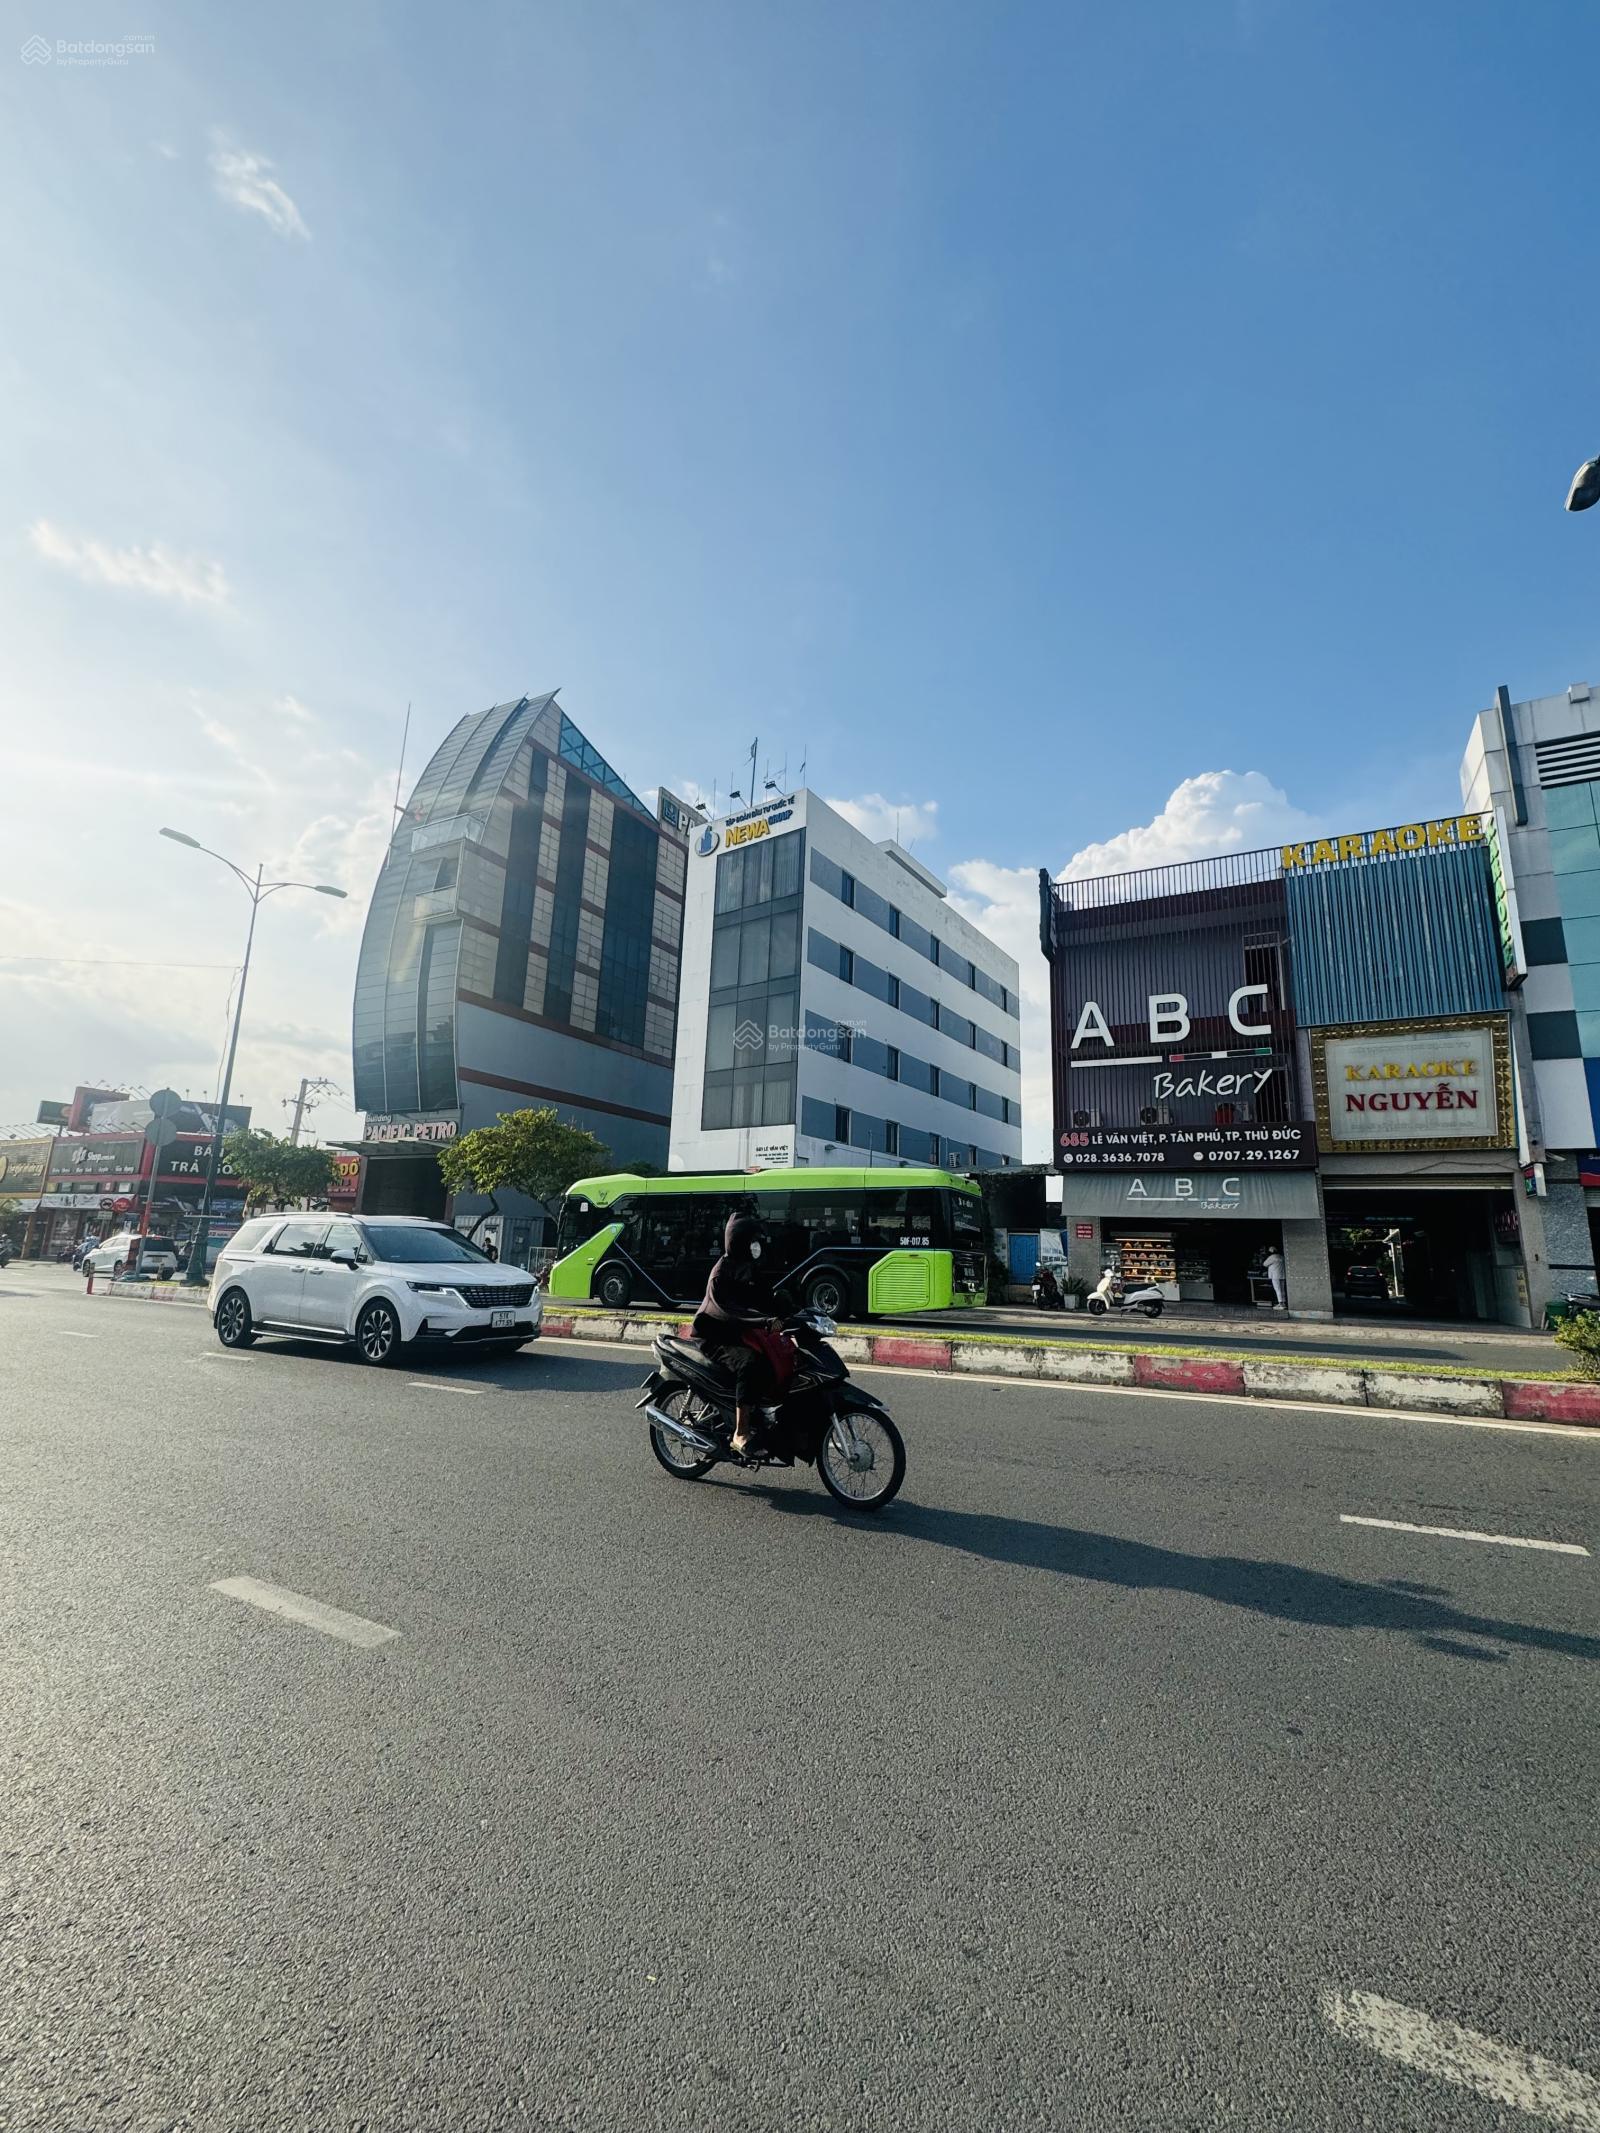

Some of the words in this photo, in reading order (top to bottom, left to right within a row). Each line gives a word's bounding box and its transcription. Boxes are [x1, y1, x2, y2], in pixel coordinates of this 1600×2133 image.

[725, 818, 771, 848] NEWA
[1282, 816, 1484, 870] KARAOKE
[1345, 1060, 1479, 1081] KARAOKE
[1153, 1068, 1273, 1099] Bakery
[1345, 1082, 1479, 1112] NGUYỄN
[366, 1113, 392, 1123] Building
[365, 1124, 411, 1141] PACIFIC
[413, 1121, 457, 1140] PETRO
[1060, 1132, 1090, 1147] 685
[1106, 1132, 1128, 1144] VĂN
[1159, 1133, 1169, 1143] P.
[1170, 1130, 1194, 1143] TÂN
[1244, 1126, 1269, 1141] THỦ
[1271, 1125, 1301, 1140] ĐỨC
[1075, 1153, 1165, 1163] 028.3636.7078
[1208, 1149, 1300, 1161] 0707.29.1267
[1200, 1201, 1240, 1210] Bakery
